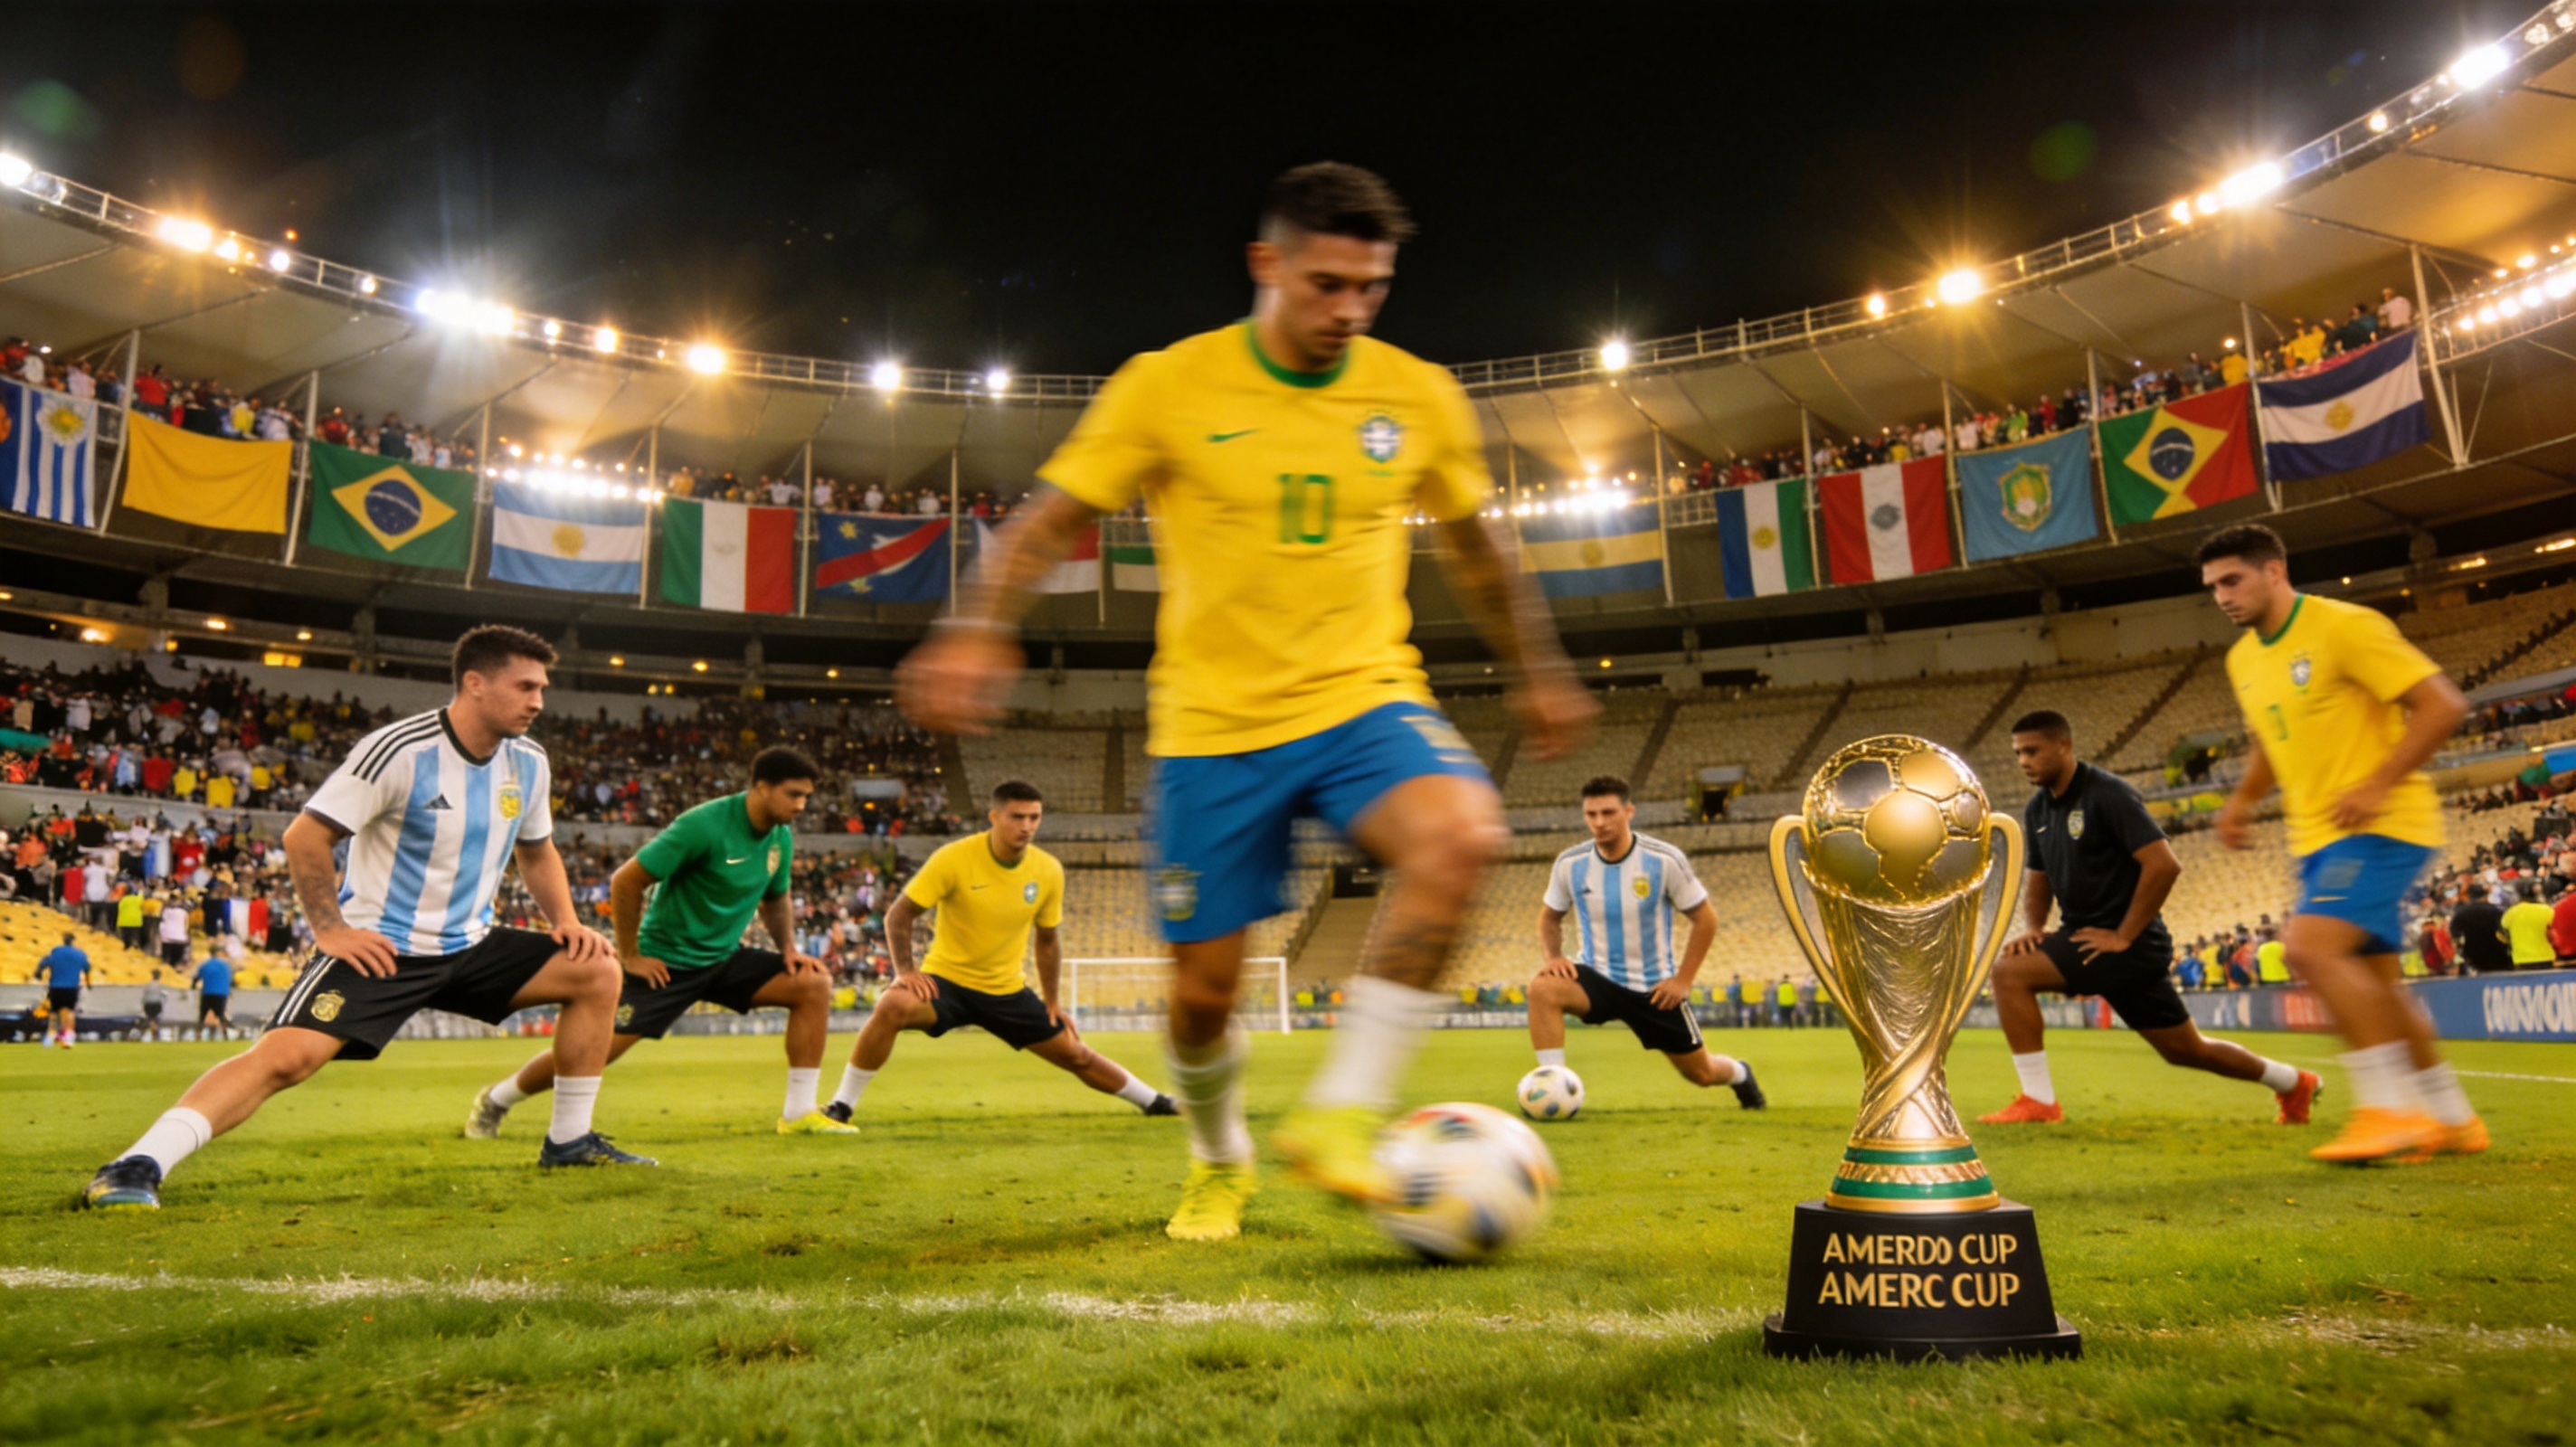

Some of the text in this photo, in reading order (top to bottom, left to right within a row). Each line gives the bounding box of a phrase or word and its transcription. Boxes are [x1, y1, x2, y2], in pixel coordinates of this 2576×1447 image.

[1278, 473, 1334, 544] 10
[1958, 1234, 2019, 1264] CUP
[1817, 1271, 2021, 1309] AMERC CUP
